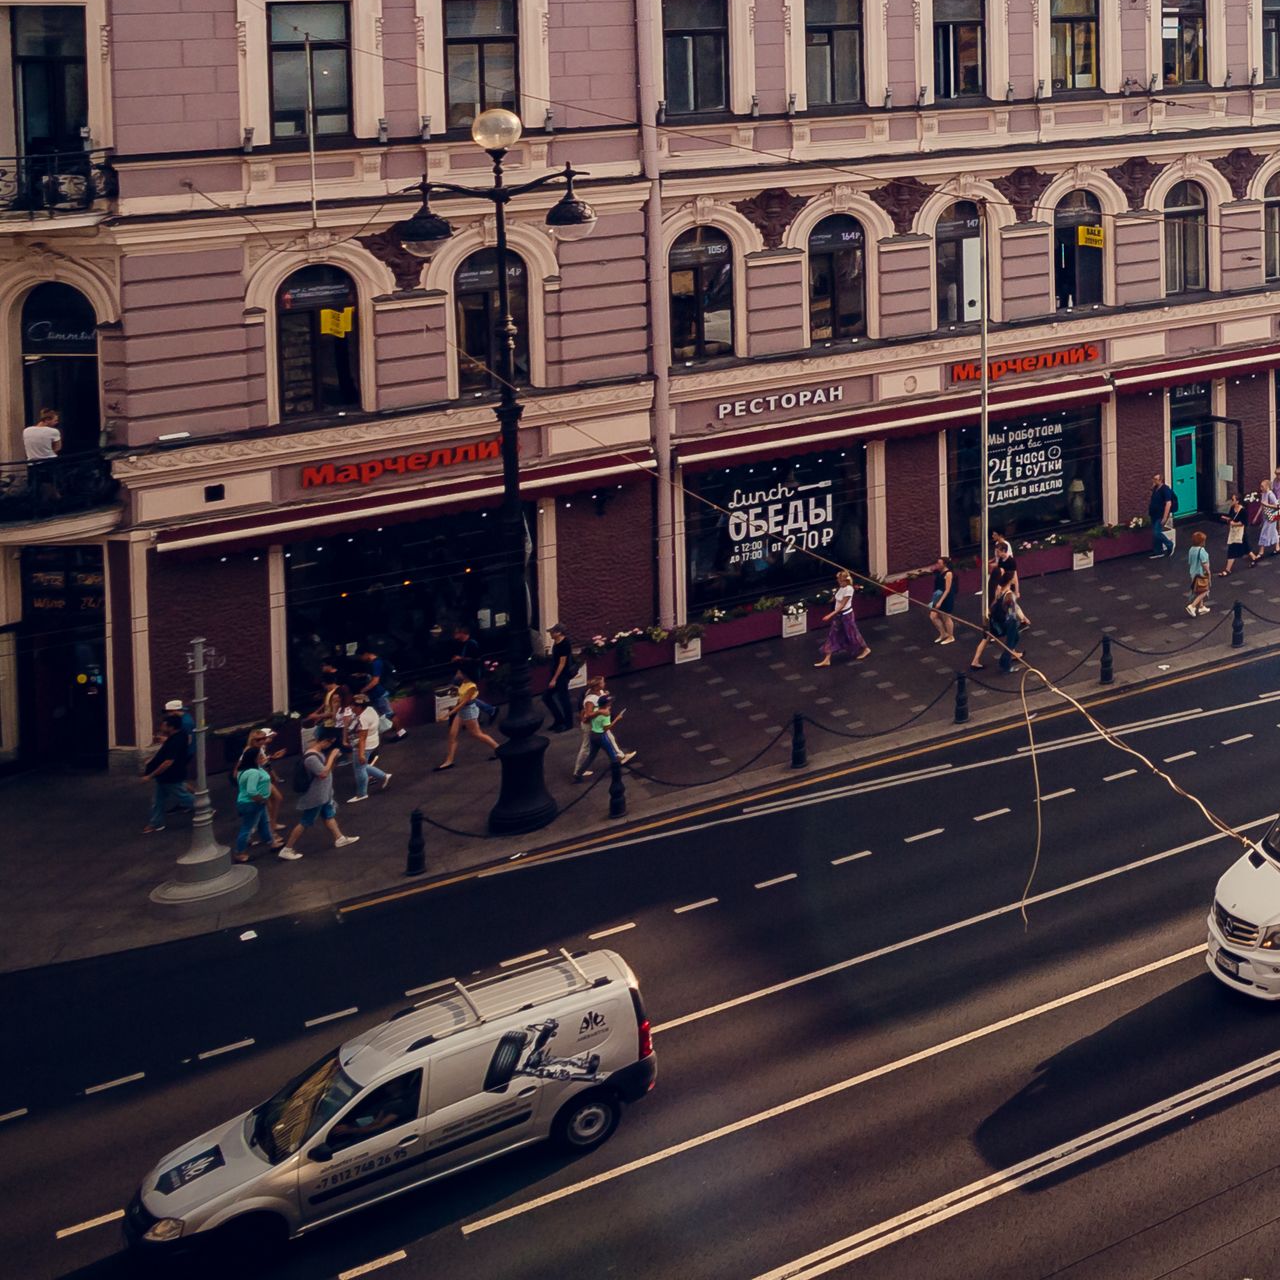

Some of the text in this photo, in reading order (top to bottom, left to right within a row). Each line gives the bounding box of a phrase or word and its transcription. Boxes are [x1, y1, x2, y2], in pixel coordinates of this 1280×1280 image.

[953, 343, 1099, 382] Марчелли's
[718, 385, 843, 419] РЕСТОРАН
[1008, 423, 1063, 443] работаем
[302, 435, 505, 488] Марчелли'
[988, 450, 1045, 485] 24 часа
[1025, 458, 1063, 477] сутки
[728, 482, 795, 509] Lunch
[988, 490, 996, 503] 7
[728, 493, 833, 541] ОБЕДЫ
[741, 540, 763, 552] 12:00
[742, 550, 763, 562] 17:00
[331, 1169, 352, 1185] 812
[377, 1153, 391, 1167] 26
[394, 1148, 408, 1160] 95
